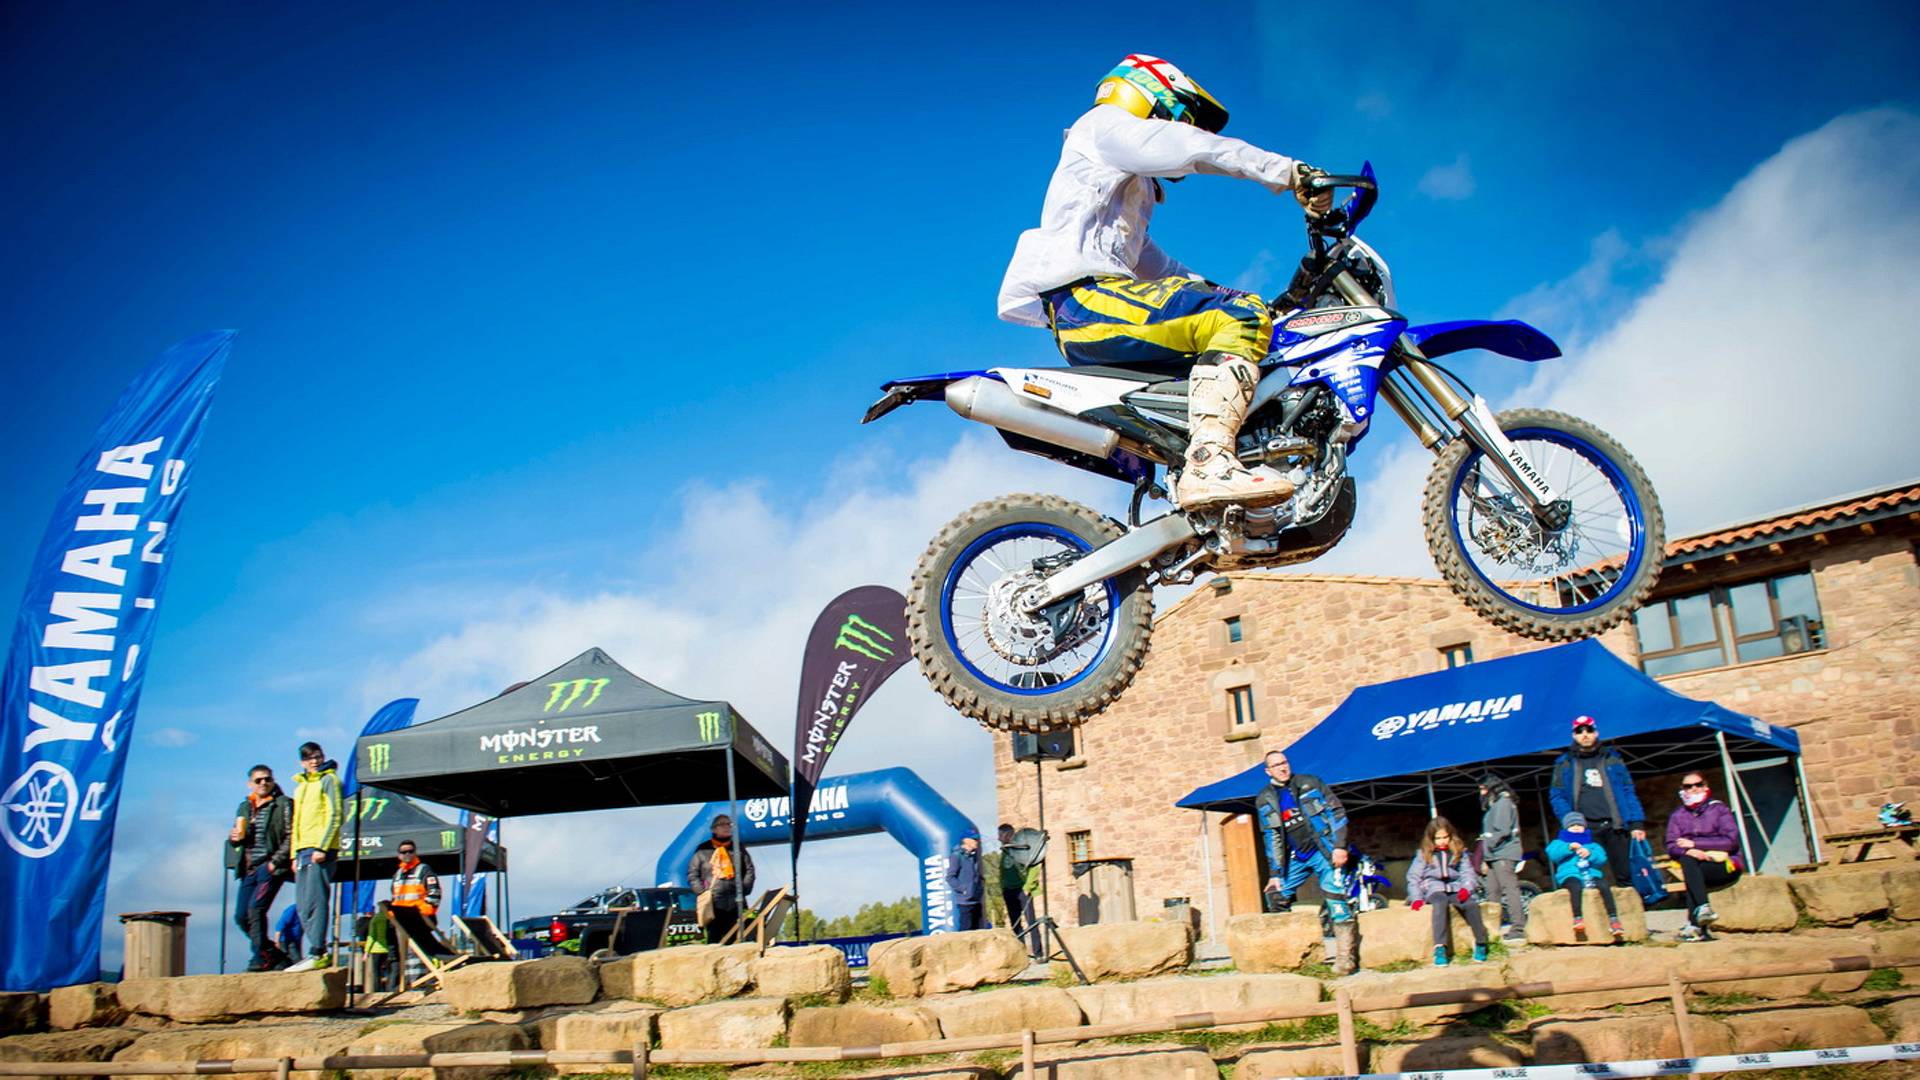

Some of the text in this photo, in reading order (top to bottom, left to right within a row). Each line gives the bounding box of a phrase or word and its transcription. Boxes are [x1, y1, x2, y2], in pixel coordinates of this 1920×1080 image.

[1508, 449, 1551, 495] YAMAHA
[23, 436, 164, 753] YAMAHA
[802, 661, 857, 764] MONSTER
[824, 682, 861, 753] ENERGY
[1407, 693, 1524, 731] YAMAHA
[480, 726, 602, 753] MONSTER
[498, 748, 585, 764] ENERGY
[769, 785, 849, 818] YAAHA
[924, 854, 946, 930] YAMAHA
